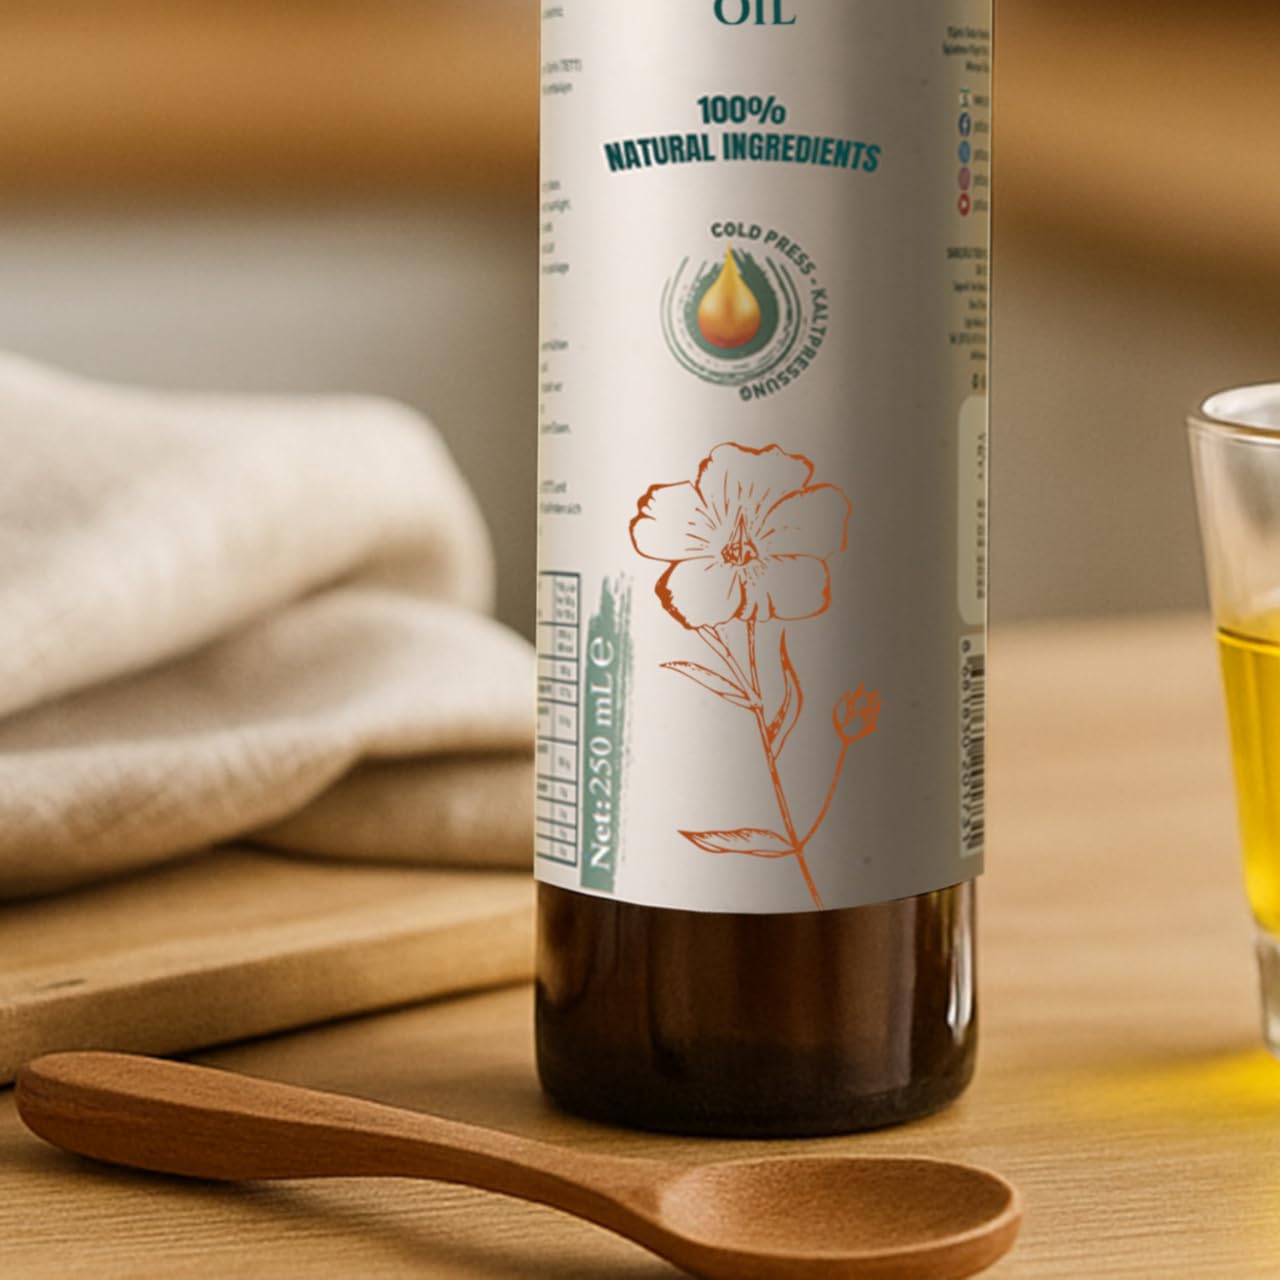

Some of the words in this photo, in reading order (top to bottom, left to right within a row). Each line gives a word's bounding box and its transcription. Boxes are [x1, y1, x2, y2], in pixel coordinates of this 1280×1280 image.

[697, 95, 787, 125] 100%
[604, 132, 716, 172] NATURAL
[722, 131, 881, 173] INGREDIENTS
[710, 222, 762, 240] COLD
[763, 229, 818, 276] PRESS
[738, 287, 829, 402] KALTPRESSUNG
[591, 672, 613, 727] mL
[589, 736, 612, 797] 250
[590, 801, 612, 871] Net:
